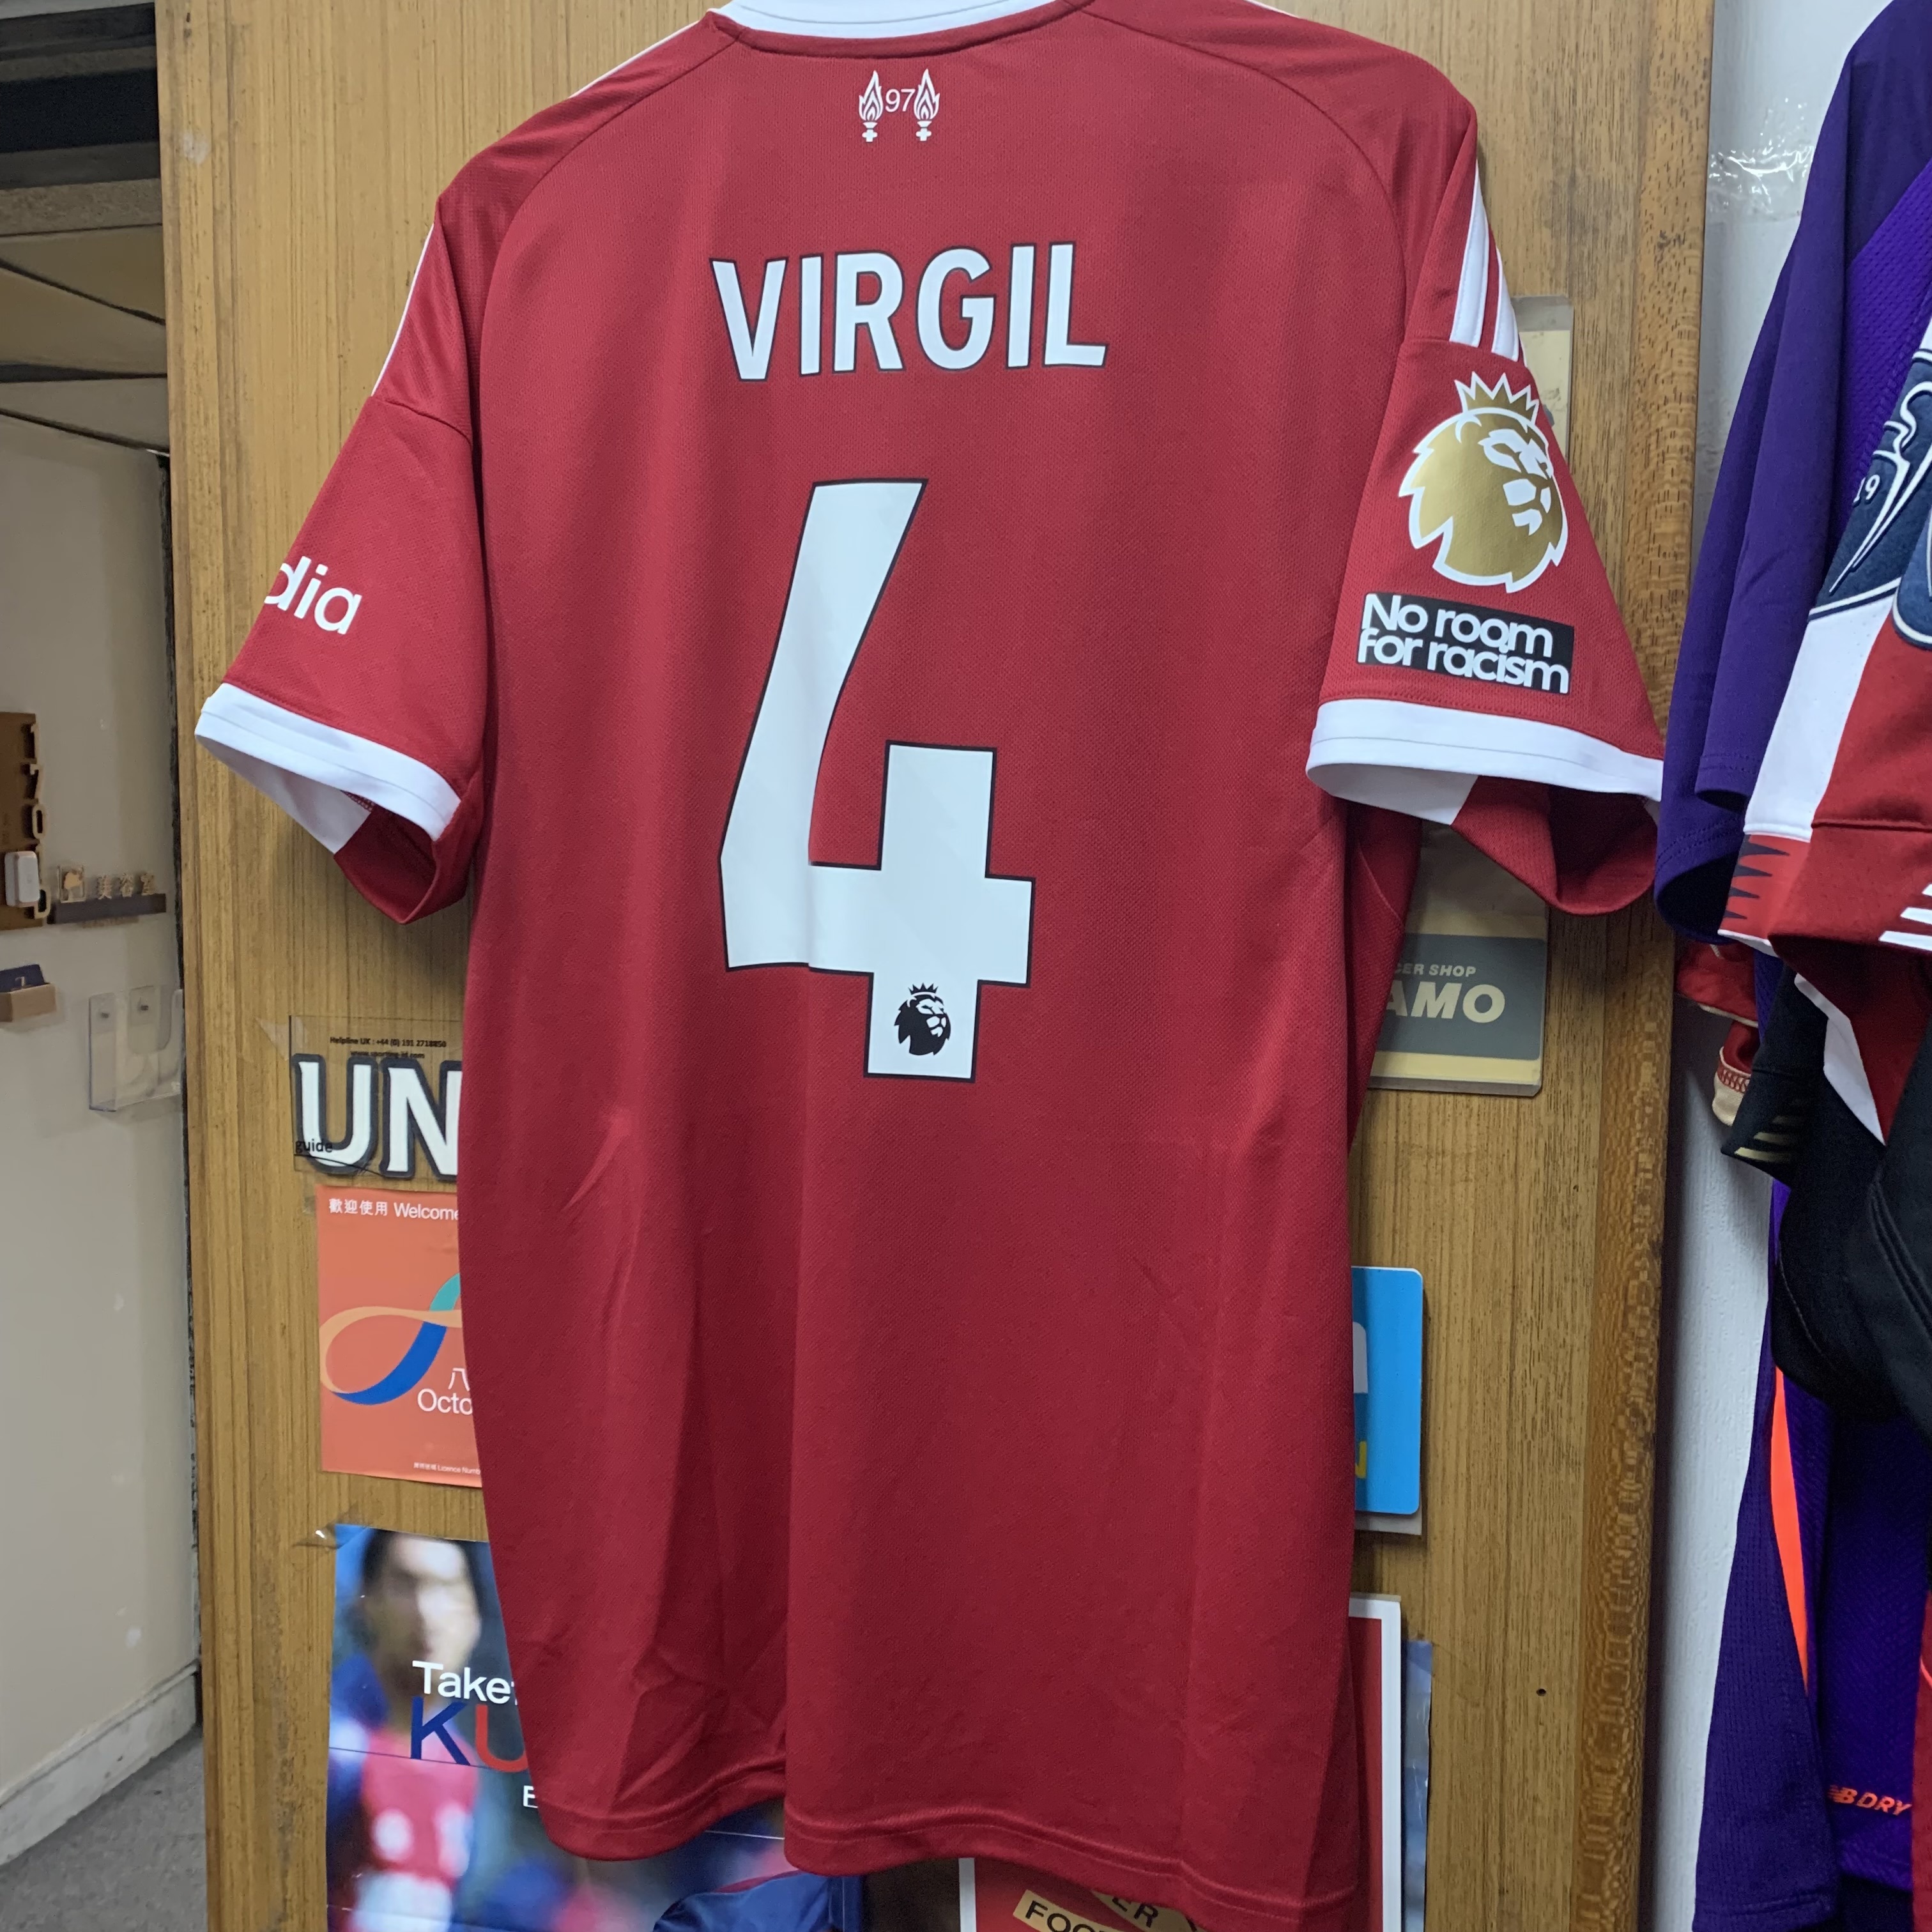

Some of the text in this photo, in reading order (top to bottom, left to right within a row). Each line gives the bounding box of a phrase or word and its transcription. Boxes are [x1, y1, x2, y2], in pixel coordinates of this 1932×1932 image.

[885, 88, 916, 112] 97
[710, 242, 1107, 381] VIRGIL
[264, 556, 362, 635] dia
[1361, 593, 1553, 658] No room
[1358, 628, 1570, 694] for racism
[718, 479, 1036, 1082] 4
[1429, 964, 1476, 977] SHOP
[1386, 979, 1505, 1023] AMO
[330, 1037, 358, 1045] Helpline
[293, 1055, 462, 1180] UN
[295, 1139, 333, 1154] guide
[329, 1198, 388, 1216] 歡迎使用
[417, 1388, 473, 1415] Octo
[412, 1660, 518, 1706] Take
[1856, 1792, 1913, 1816] DRY
